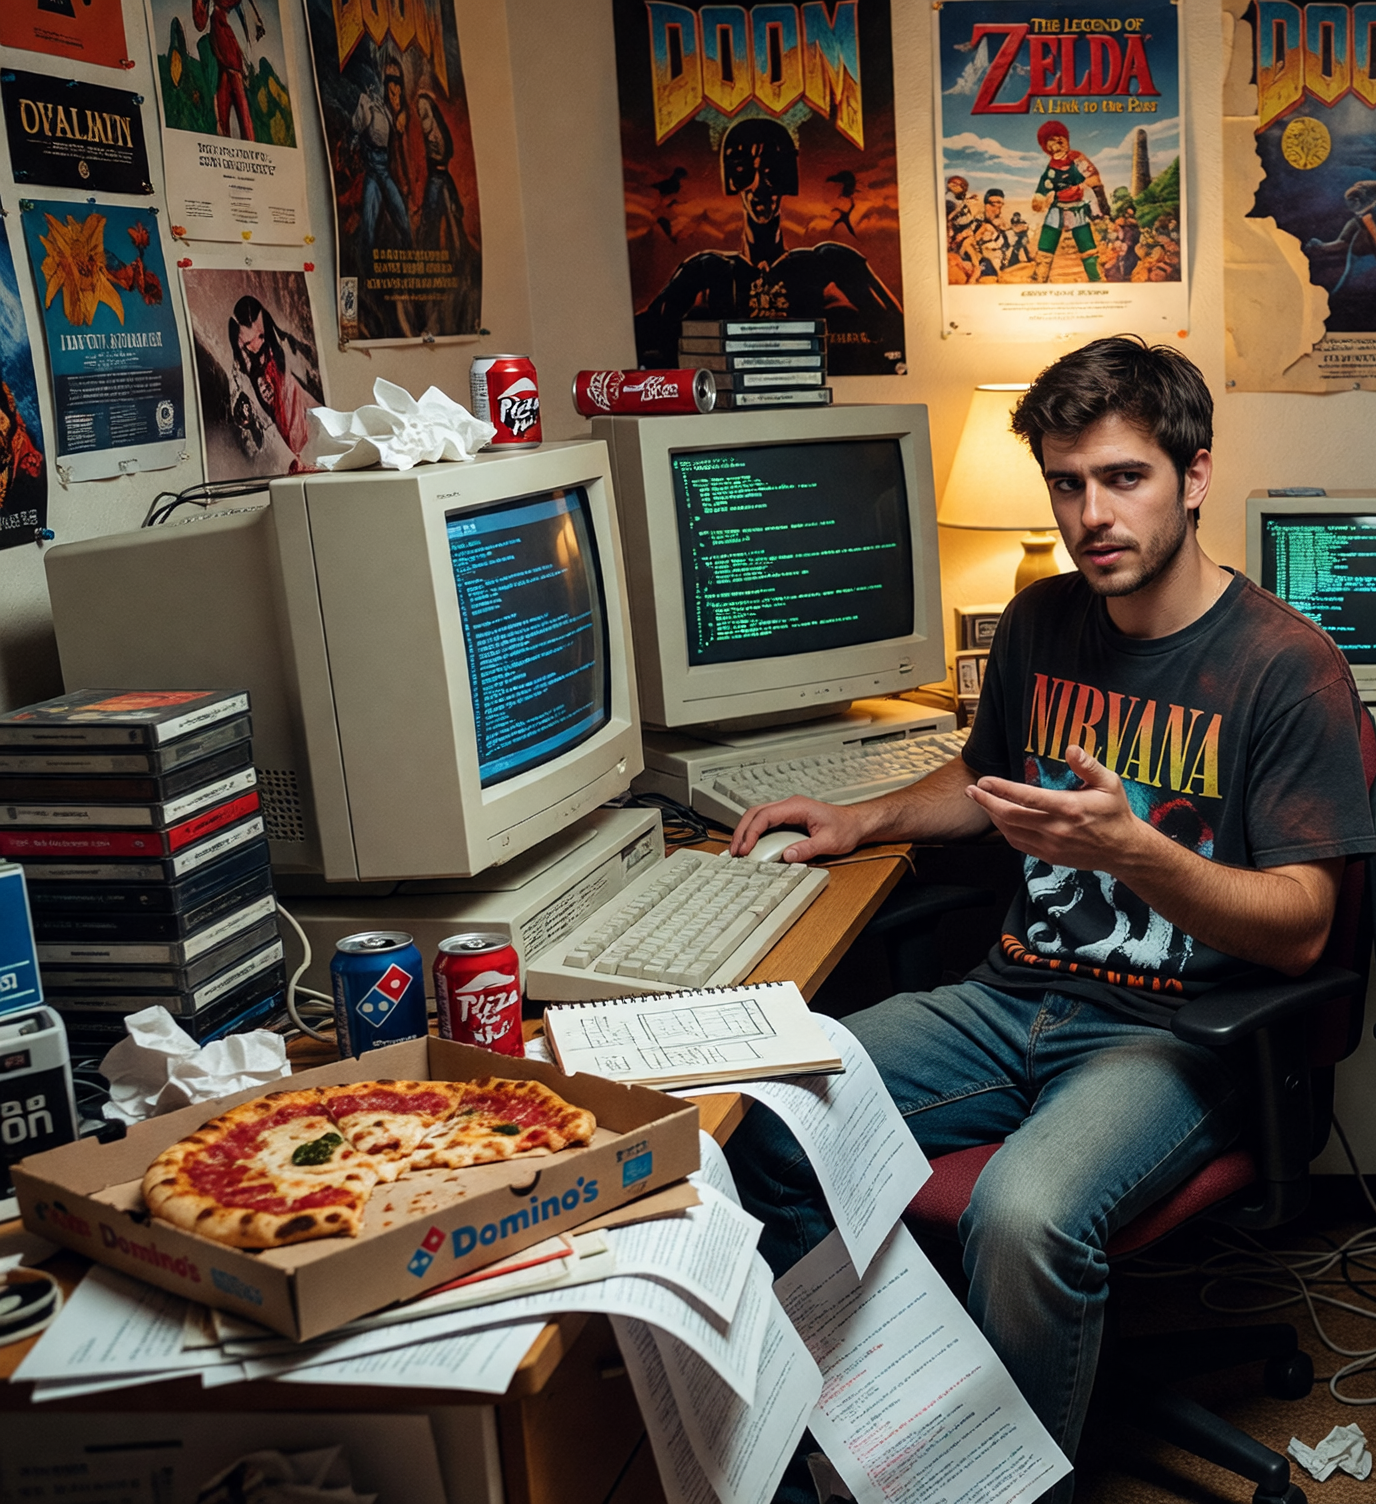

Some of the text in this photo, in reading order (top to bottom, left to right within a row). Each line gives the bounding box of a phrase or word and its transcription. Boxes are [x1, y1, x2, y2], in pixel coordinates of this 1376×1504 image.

[1125, 18, 1145, 31] OF
[646, 0, 865, 151] DOOM
[970, 23, 1161, 115] ZELDA
[1033, 98, 1045, 114] A
[1024, 673, 1223, 799] NIRVANA
[451, 1176, 599, 1260] Domino's
